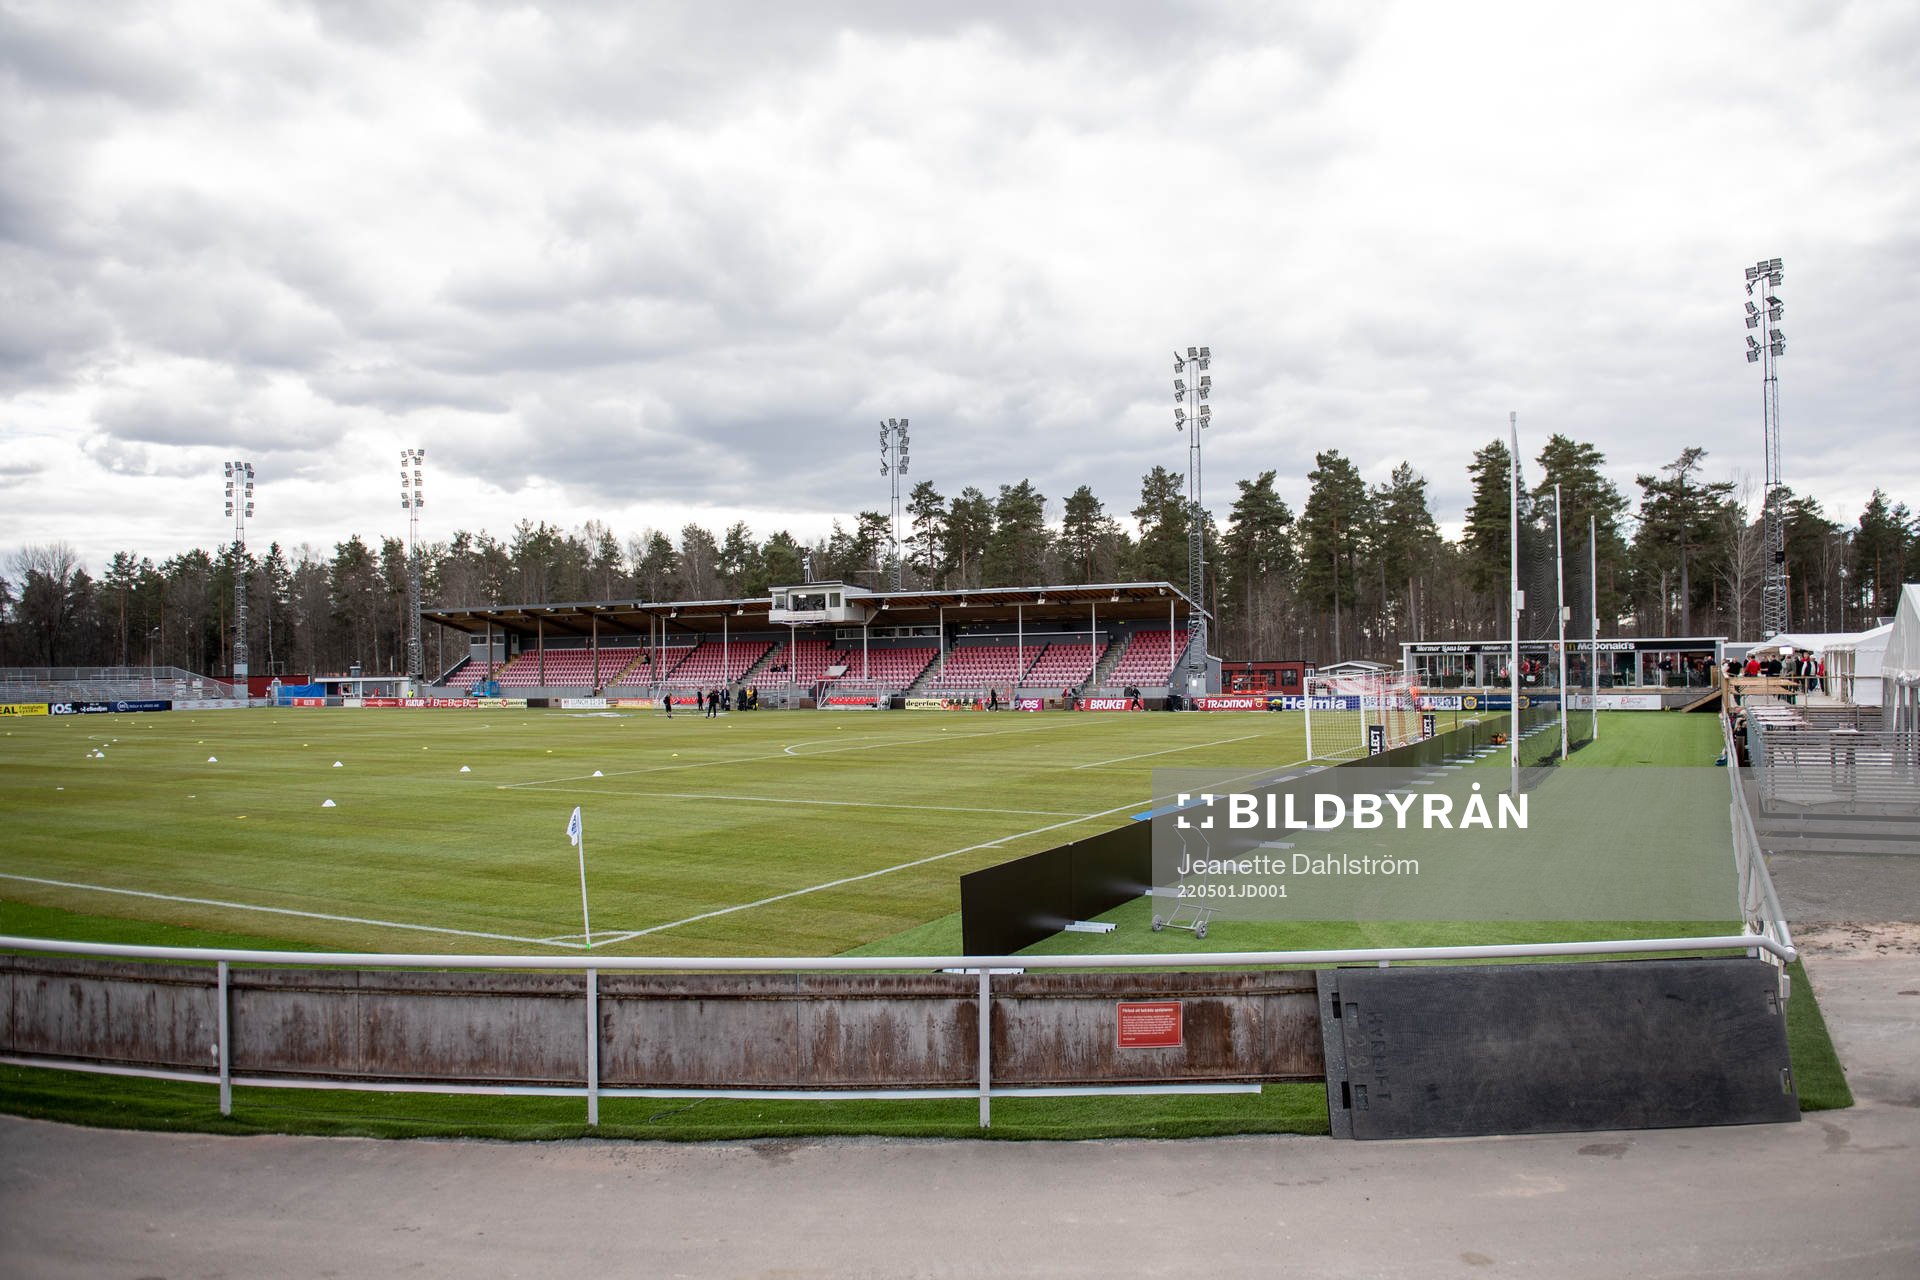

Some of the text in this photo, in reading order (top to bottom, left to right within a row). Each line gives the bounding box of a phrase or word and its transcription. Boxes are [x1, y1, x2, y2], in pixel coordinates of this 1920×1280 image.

[1577, 642, 1635, 650] McDonald's
[906, 700, 941, 708] degerfors
[1090, 699, 1127, 710] BRUKET
[1207, 699, 1253, 709] TRADITION
[1282, 696, 1347, 710] Helmia
[1424, 718, 1432, 740] ELECT
[1370, 730, 1381, 756] ELECT
